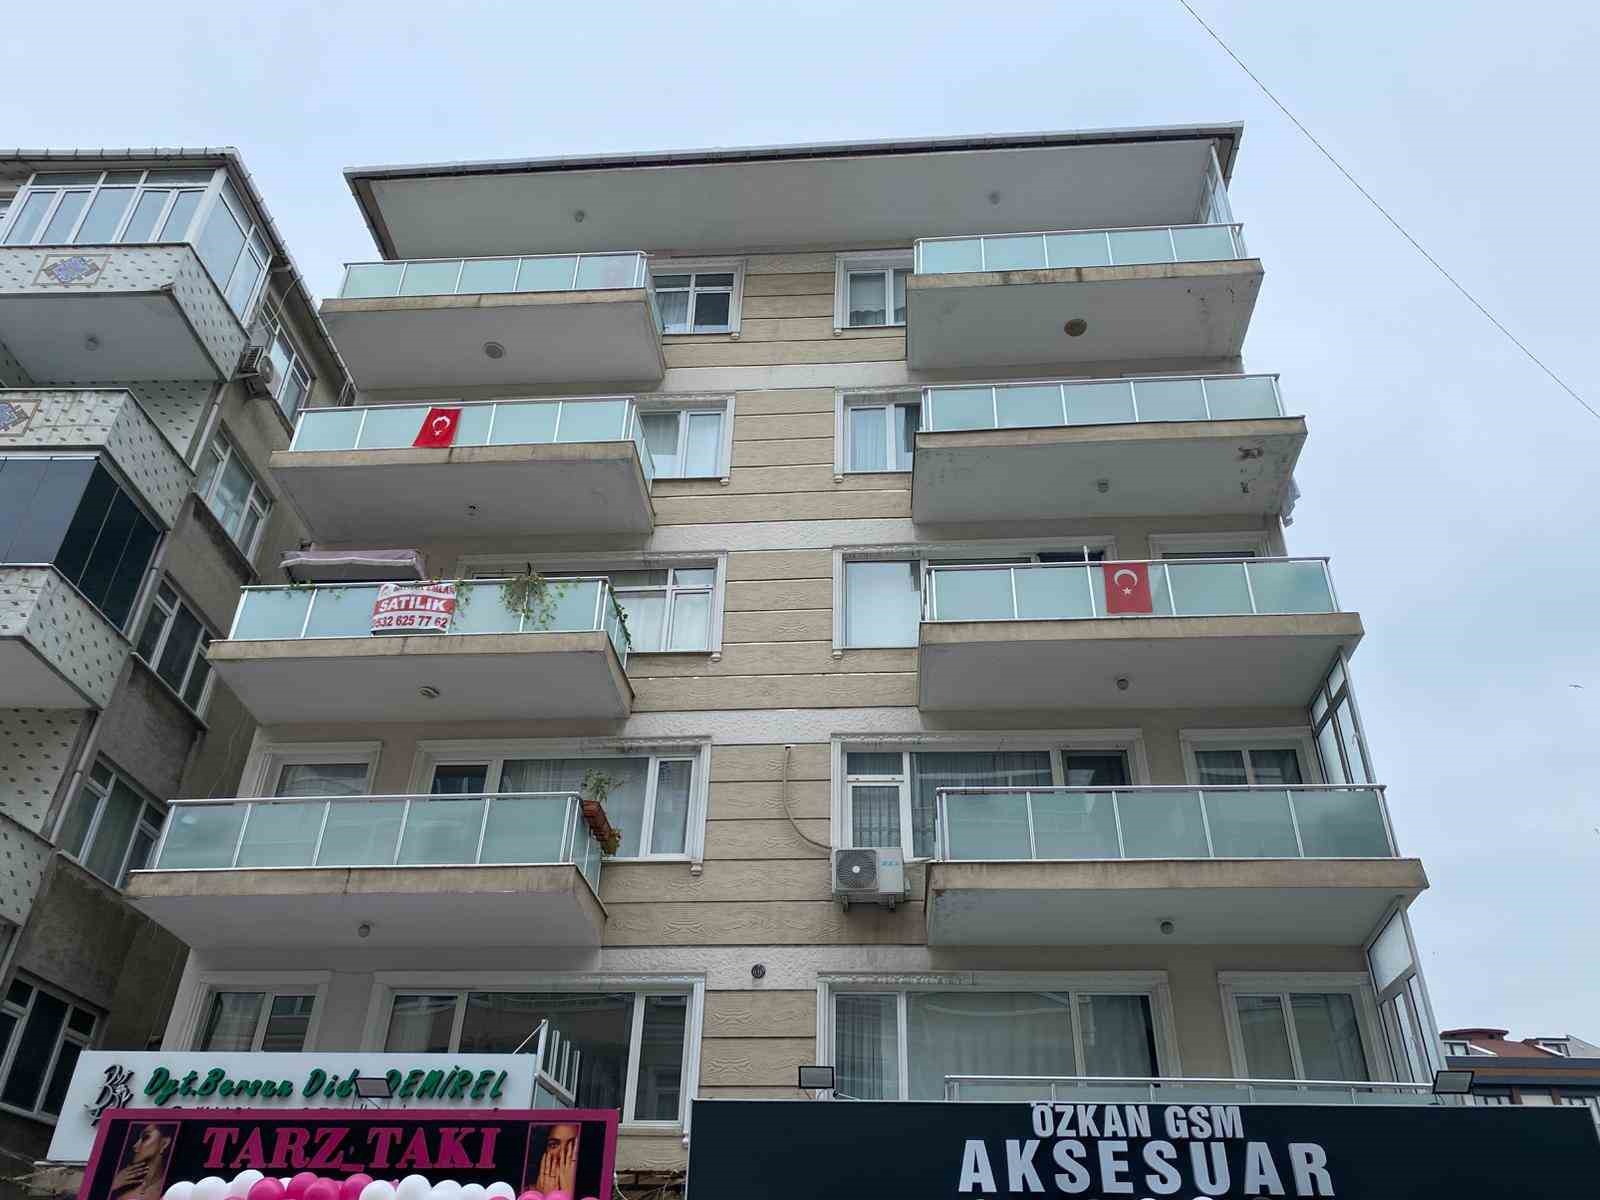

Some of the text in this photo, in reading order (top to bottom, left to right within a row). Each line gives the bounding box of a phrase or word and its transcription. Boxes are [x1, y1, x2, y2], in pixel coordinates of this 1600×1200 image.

[396, 615, 415, 626] 625
[418, 615, 432, 627] 77
[434, 617, 448, 629] 62
[1030, 1101, 1245, 1139] ÖZKAN GSM
[957, 1139, 1336, 1197] AKSESUAR
